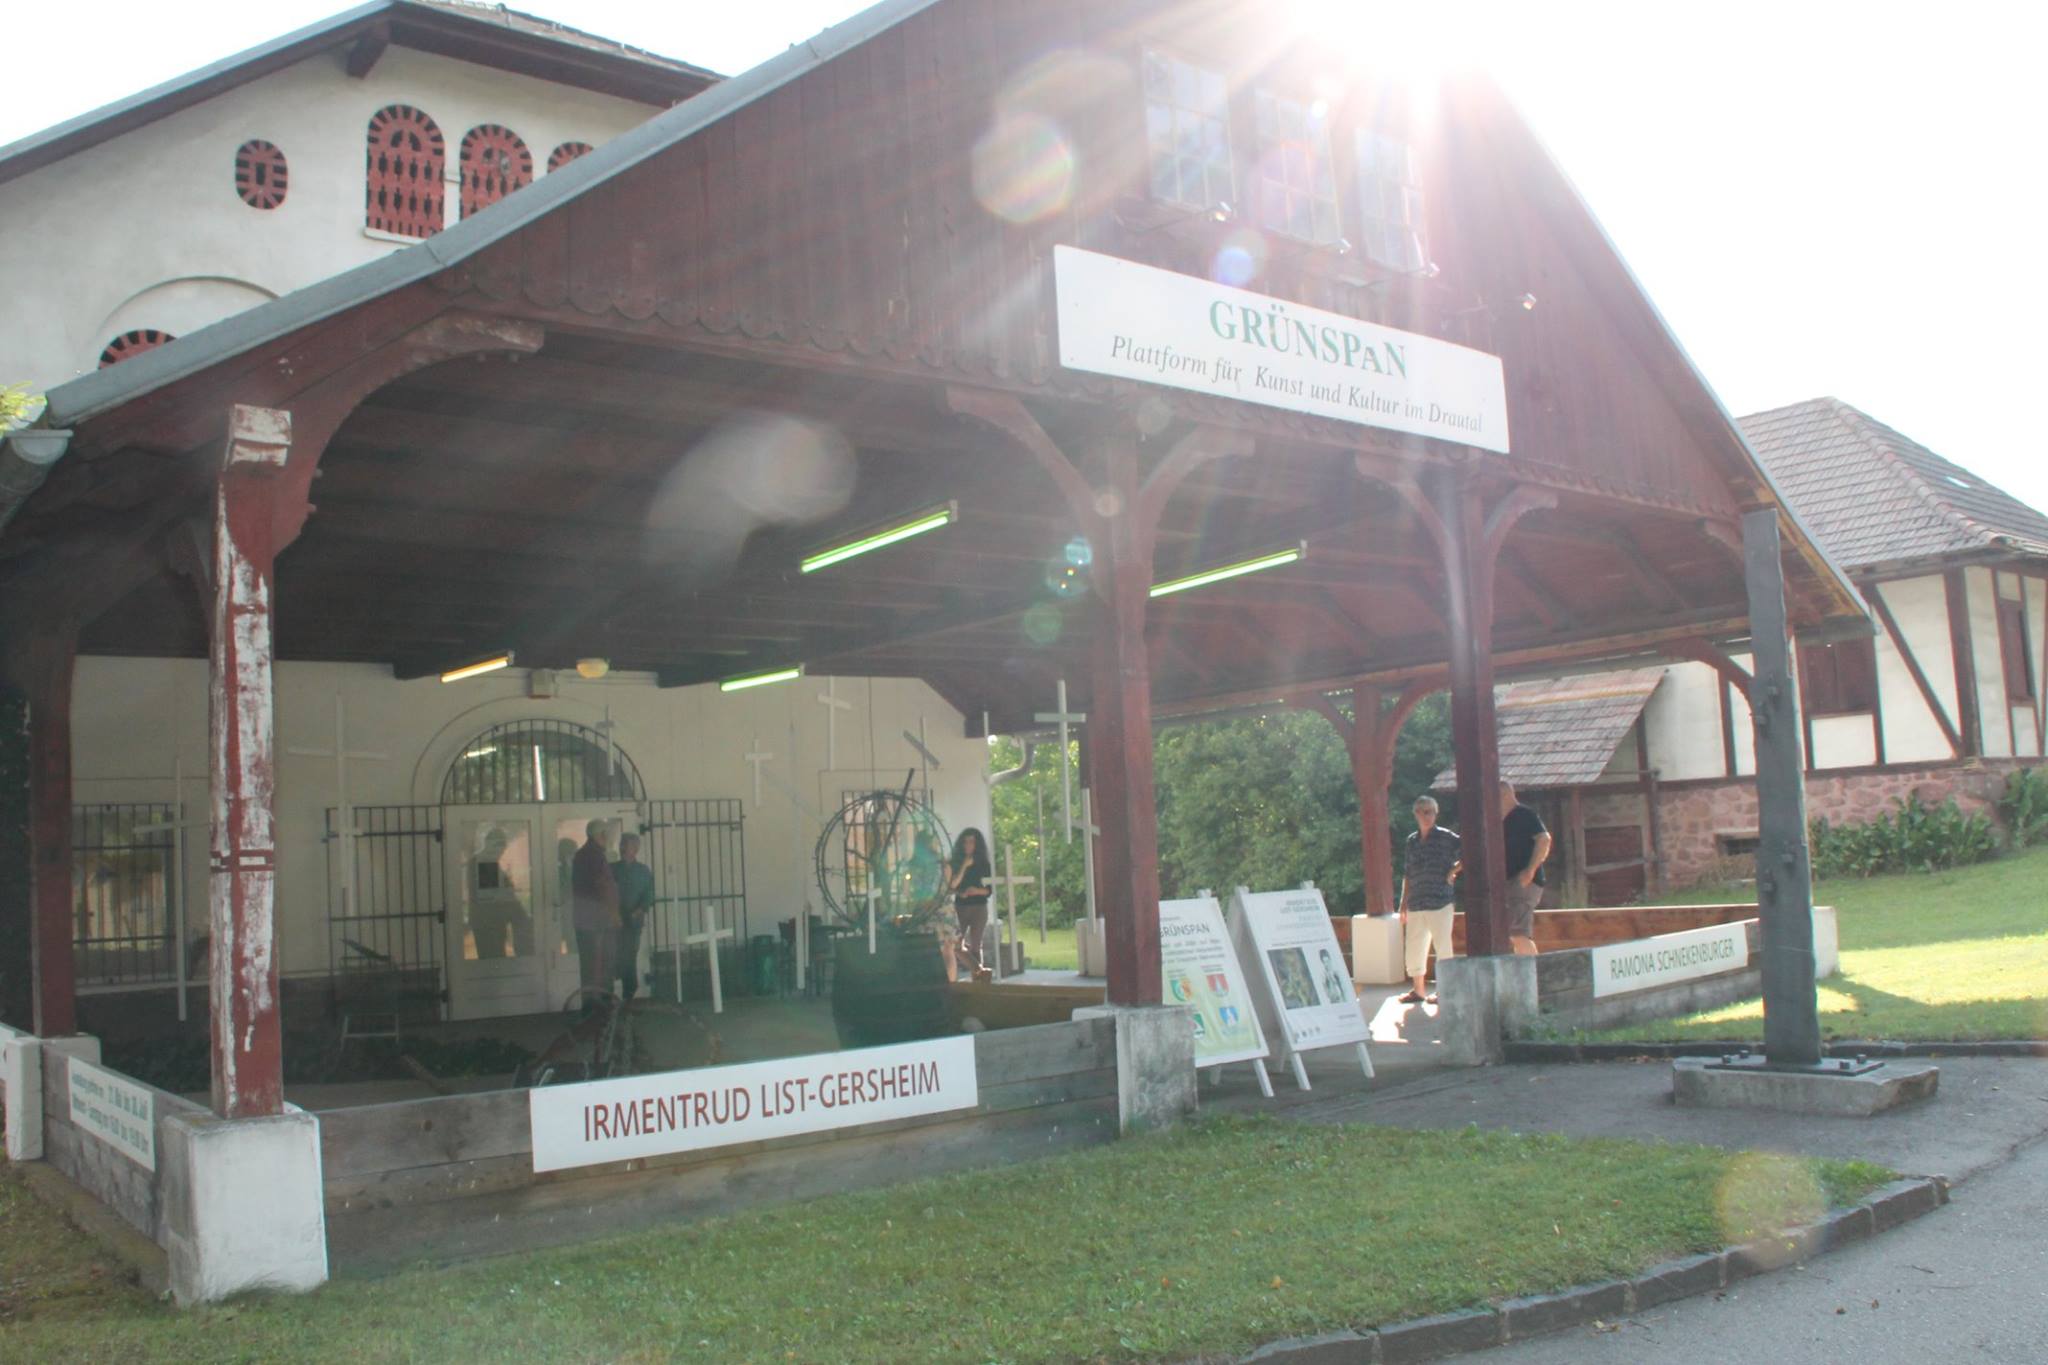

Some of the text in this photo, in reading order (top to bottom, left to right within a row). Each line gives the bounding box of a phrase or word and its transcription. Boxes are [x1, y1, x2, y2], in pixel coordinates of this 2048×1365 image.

[1209, 299, 1408, 379] GRÜNSPAN
[1111, 335, 1483, 433] Plattform für Kunst und Kultur im Drautal
[1610, 938, 1734, 980] RAMONA SCHNEKENBURGER
[583, 1061, 941, 1142] IRMENTRUD LIST-GERSHEIM
